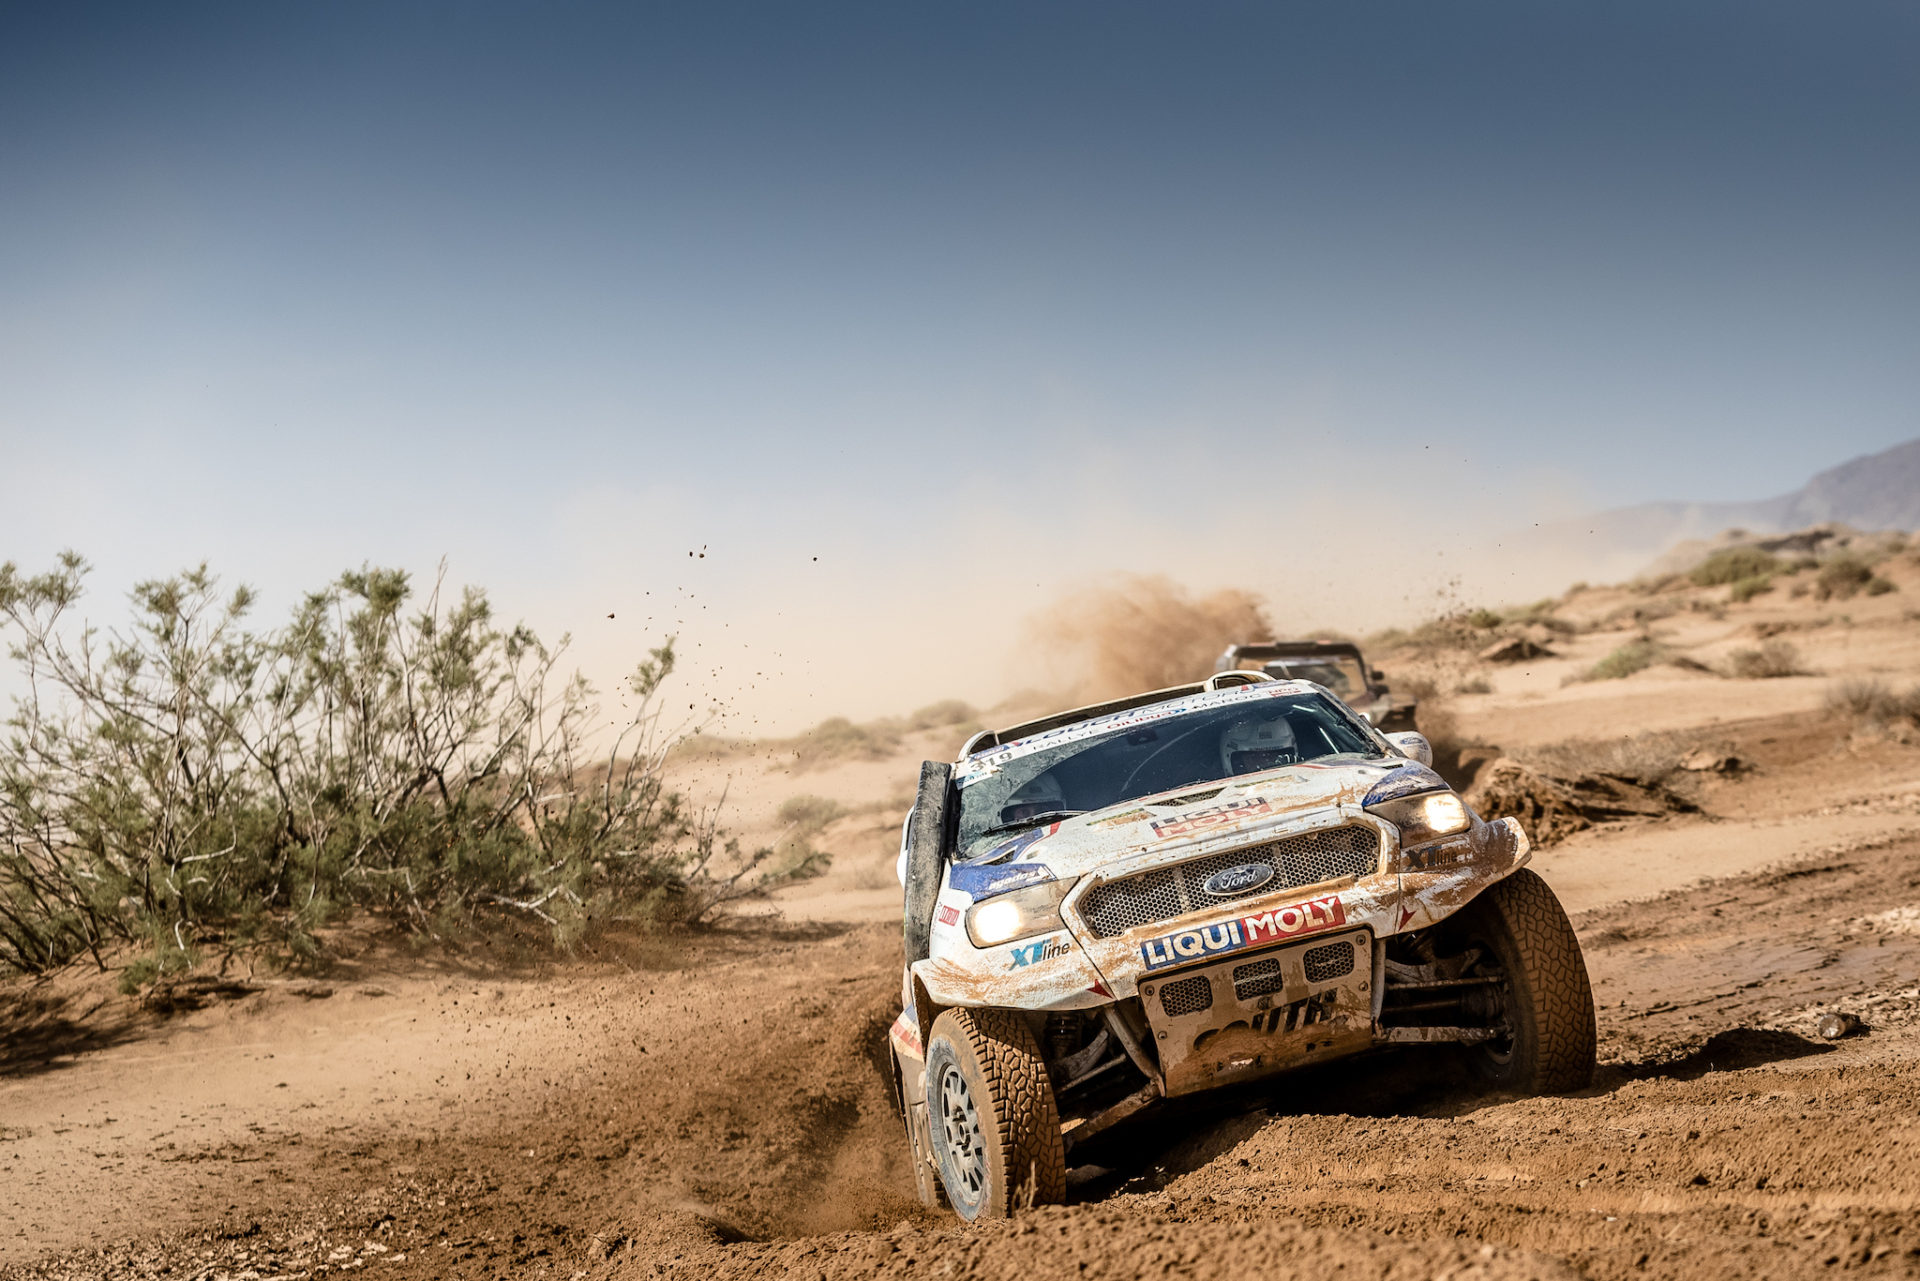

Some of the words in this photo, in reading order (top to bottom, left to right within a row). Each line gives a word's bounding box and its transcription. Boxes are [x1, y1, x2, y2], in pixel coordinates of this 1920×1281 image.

[970, 751, 1013, 773] 319
[1160, 803, 1269, 837] MOLY
[1219, 868, 1258, 890] Ford
[1144, 921, 1242, 965] LIQUI
[1244, 896, 1339, 941] MOLY
